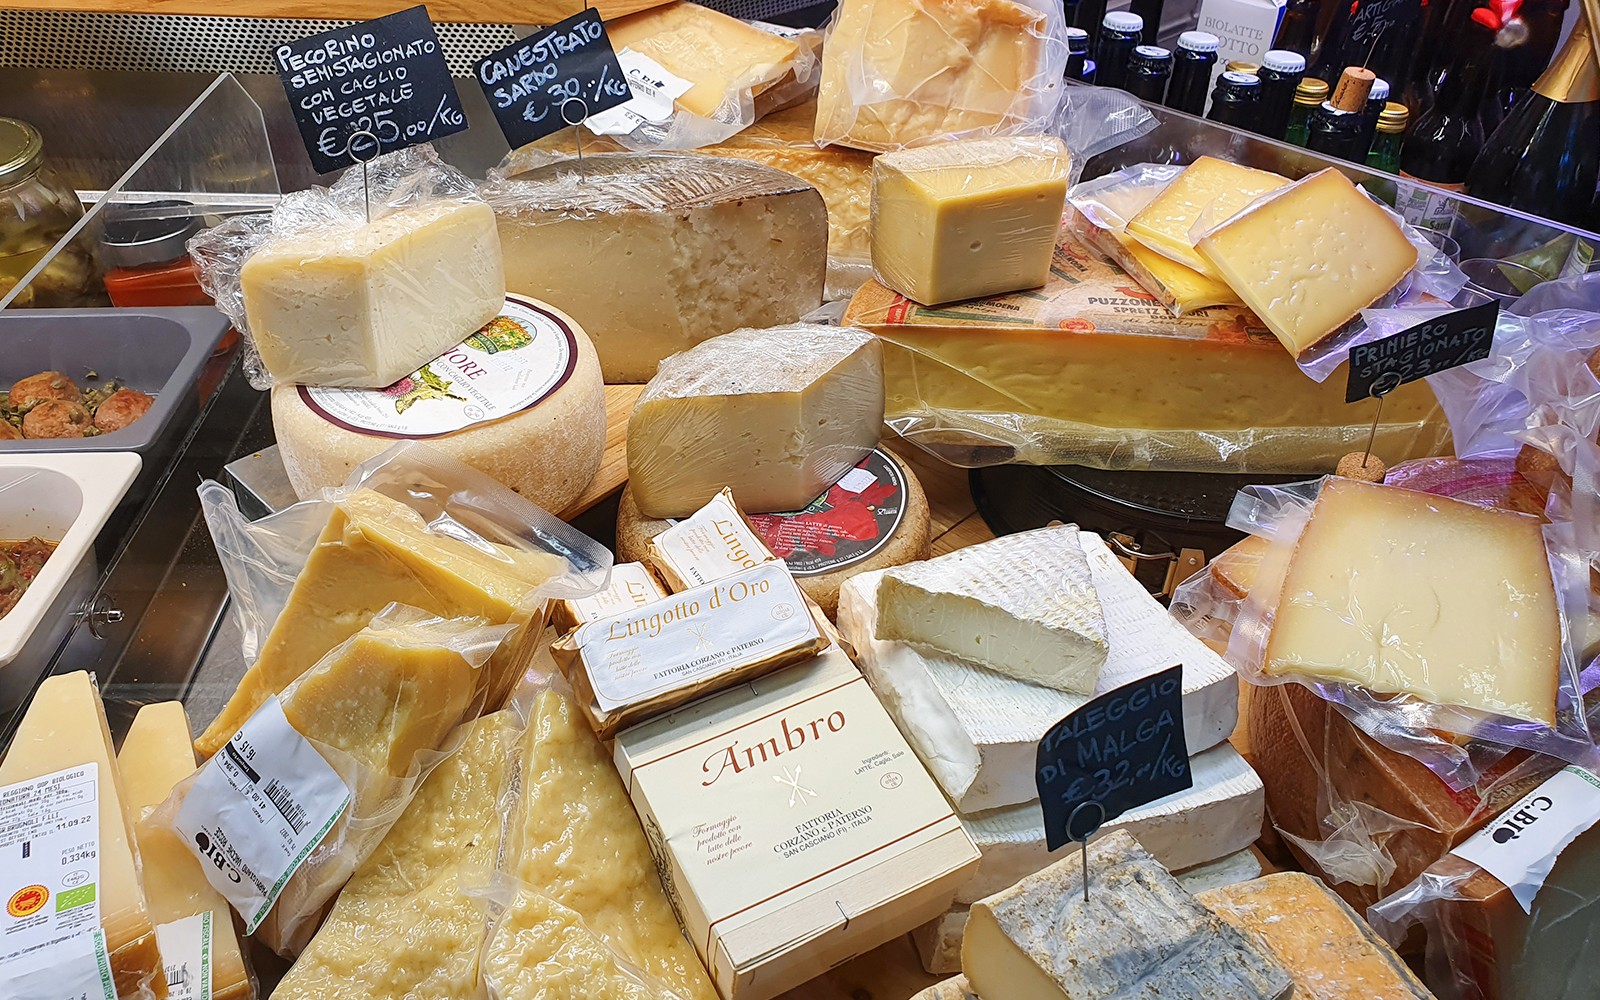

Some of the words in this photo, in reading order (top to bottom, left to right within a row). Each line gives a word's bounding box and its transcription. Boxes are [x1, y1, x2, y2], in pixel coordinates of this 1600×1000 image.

[1204, 16, 1264, 41] BIOLATTE
[1207, 32, 1259, 56] OTTO
[277, 33, 375, 72] PECORINO
[291, 39, 435, 89] SEMISTAGIONATO
[480, 19, 602, 85] CANESTRATO
[300, 87, 335, 110] CON
[340, 66, 407, 95] CAGLIO
[312, 83, 413, 125] VEGETALE
[493, 62, 559, 109] SARDO
[1088, 297, 1161, 307] PUZZONE
[1113, 306, 1160, 316] SPRETZ
[441, 348, 488, 381] IORE
[1355, 324, 1447, 366] PRIMIERO
[1360, 328, 1487, 378] STAGIONATO
[605, 600, 701, 644] Lingotto
[709, 579, 770, 610] d'Oro
[653, 662, 690, 680] FATTORIA
[690, 650, 726, 668] CORZANO
[731, 637, 765, 653] PATERNO
[682, 668, 693, 677] SAN
[1041, 678, 1178, 753] TALEGGIO
[702, 710, 846, 787] Ambro
[1039, 758, 1067, 784] DI
[1076, 709, 1174, 768] MALGA
[3, 785, 34, 798] REGGIANO
[52, 771, 85, 784] BIOLOGICO
[45, 784, 61, 794] MESI
[692, 814, 737, 838] Formaggio
[696, 829, 727, 851] prodotto
[728, 825, 742, 834] con
[773, 828, 820, 853] CORZANO
[821, 825, 828, 833] e
[827, 804, 873, 830] PATERNO
[783, 848, 799, 859] SAN
[799, 831, 836, 852] CASCIANO
[851, 815, 873, 829] ITALIA
[794, 808, 843, 834] FATTORIA
[240, 863, 268, 897] PARMIGIANO
